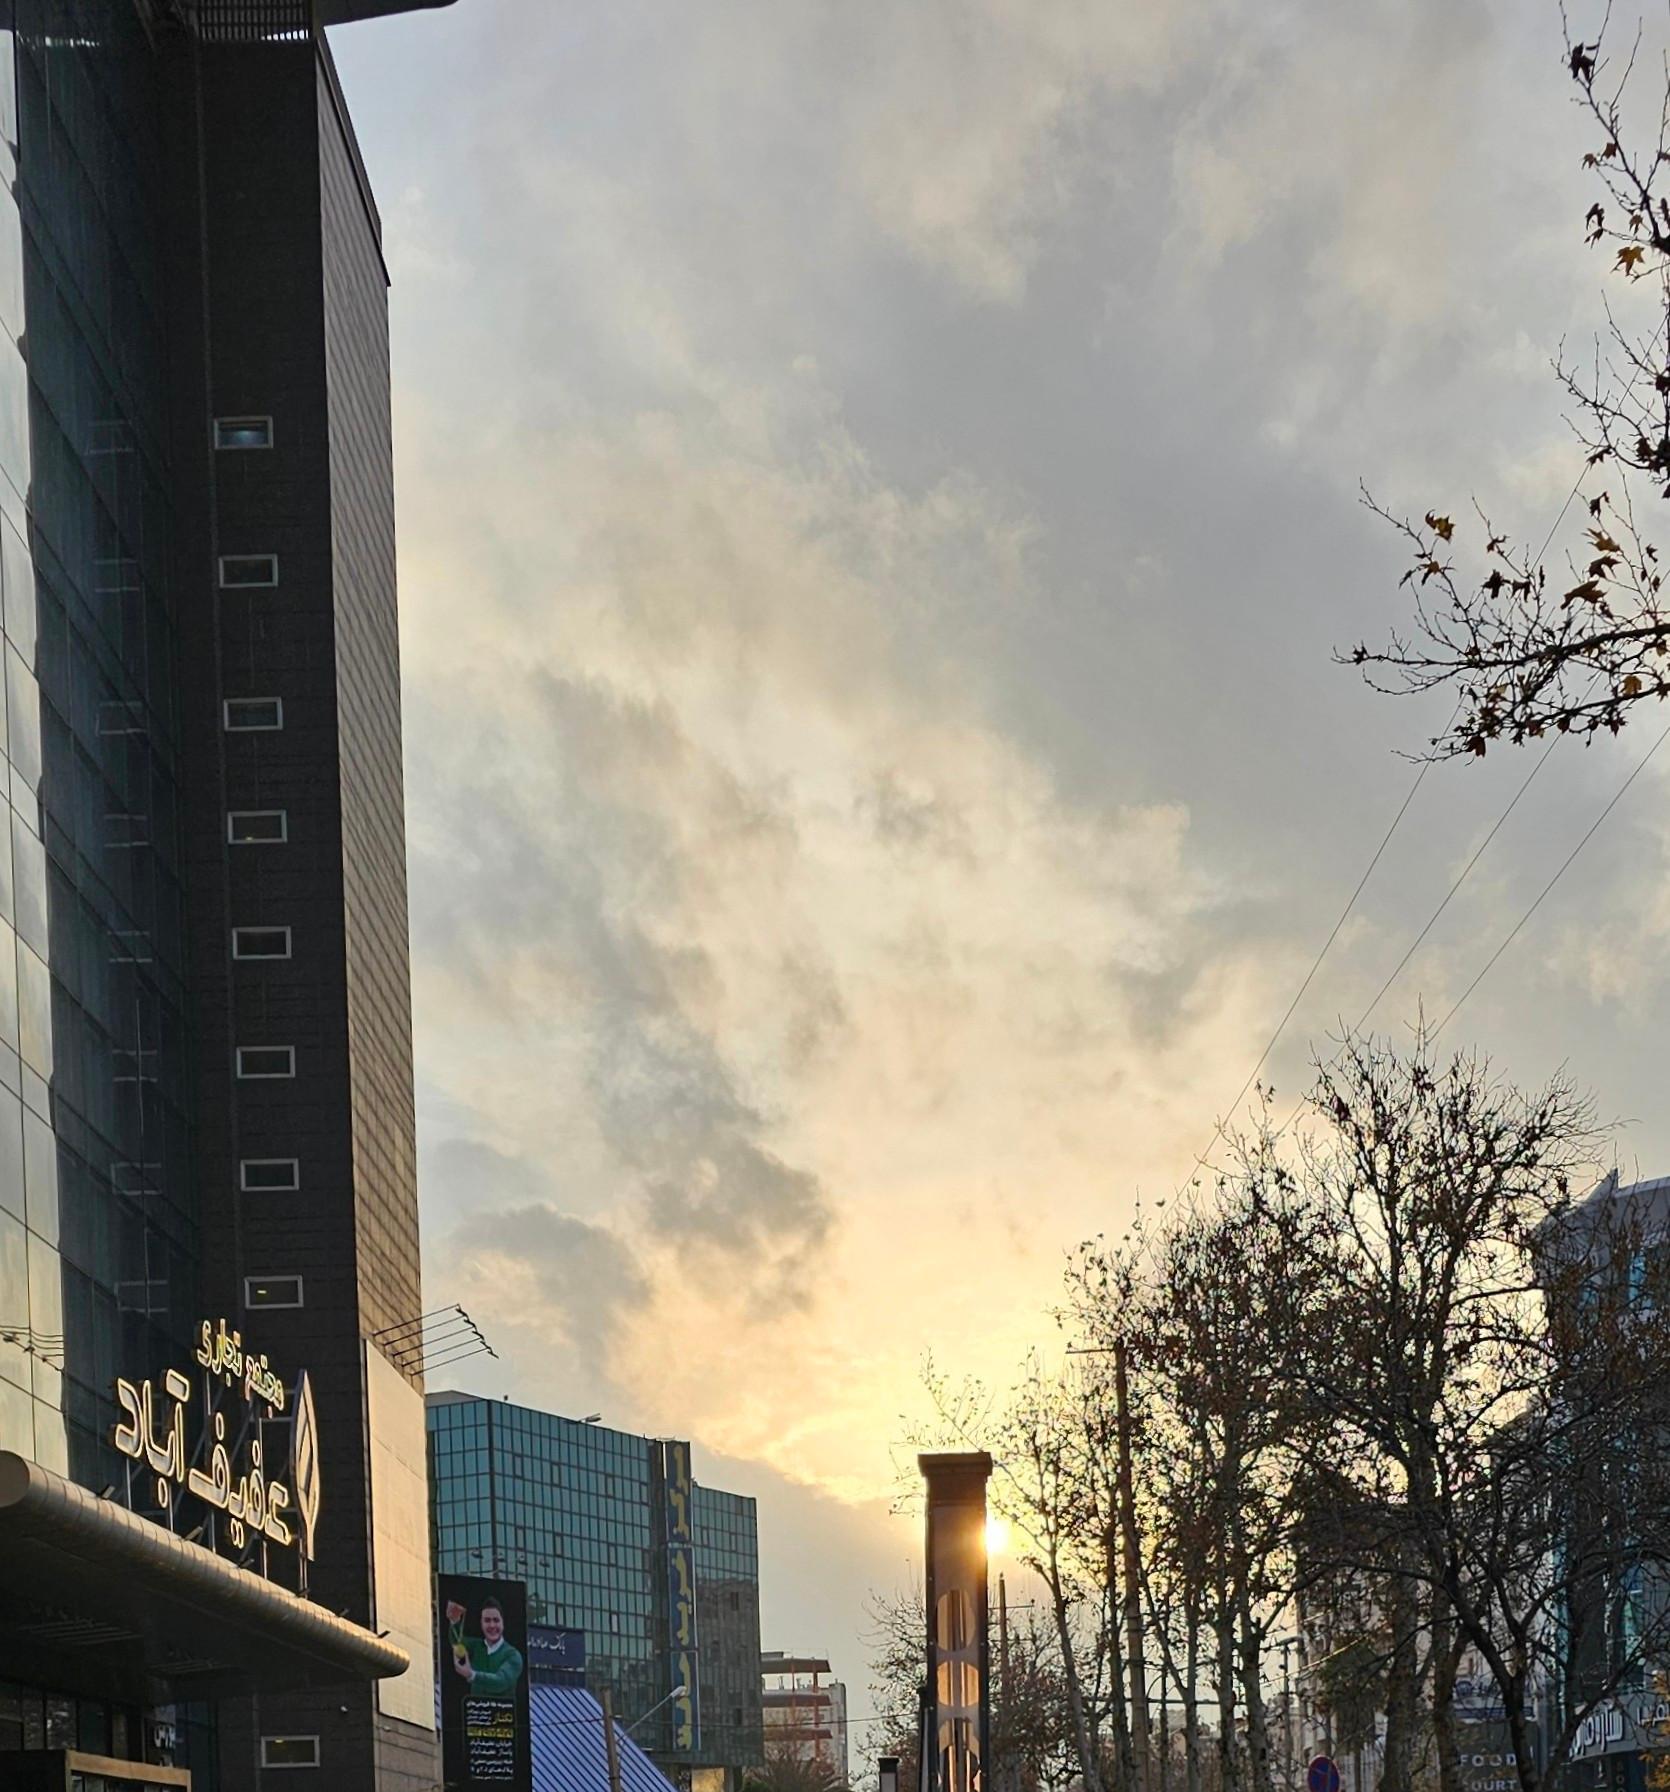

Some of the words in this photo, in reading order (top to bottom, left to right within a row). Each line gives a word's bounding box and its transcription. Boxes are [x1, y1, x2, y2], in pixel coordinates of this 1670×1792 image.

[196, 1318, 242, 1387] تجاری
[115, 1368, 190, 1508] آباد
[188, 1412, 292, 1549] عفیف
[1459, 1753, 1518, 1767] FOOD
[1462, 1779, 1517, 1792] OURT
